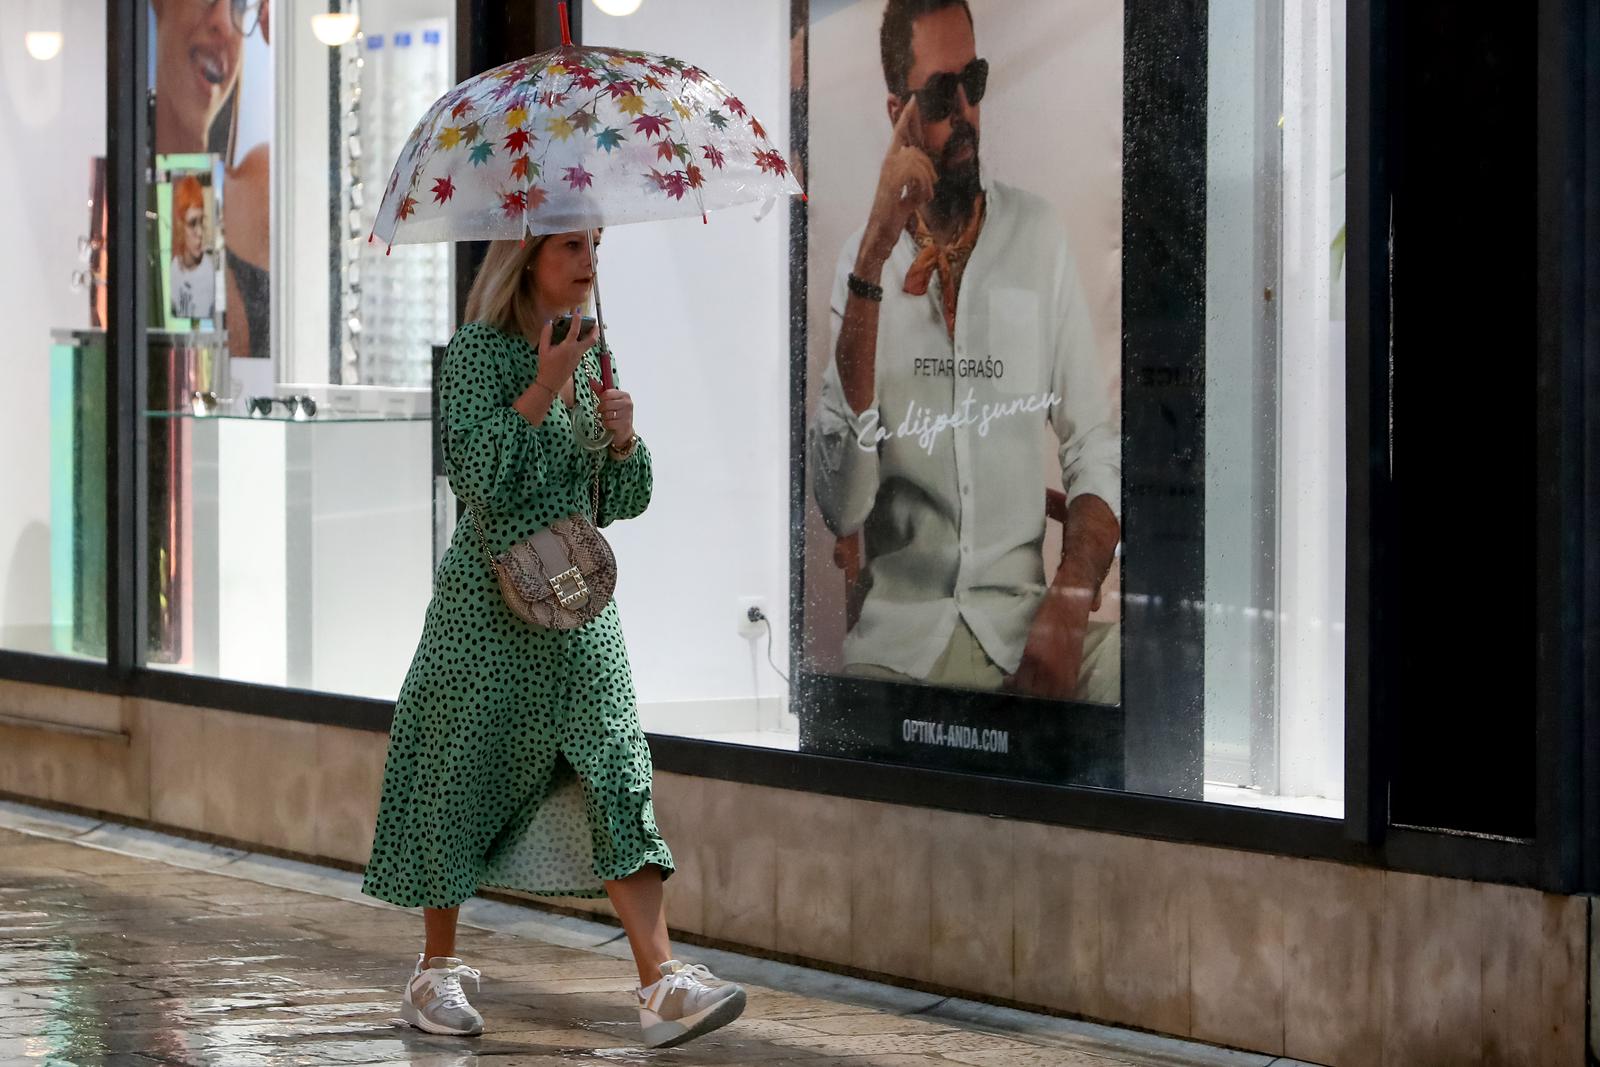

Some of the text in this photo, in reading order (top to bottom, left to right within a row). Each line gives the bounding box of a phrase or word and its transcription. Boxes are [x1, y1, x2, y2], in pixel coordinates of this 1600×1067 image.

[914, 358, 954, 377] PETAR
[857, 408, 892, 452] Za
[902, 718, 1009, 754] OPTIKA-ANDA.COM
